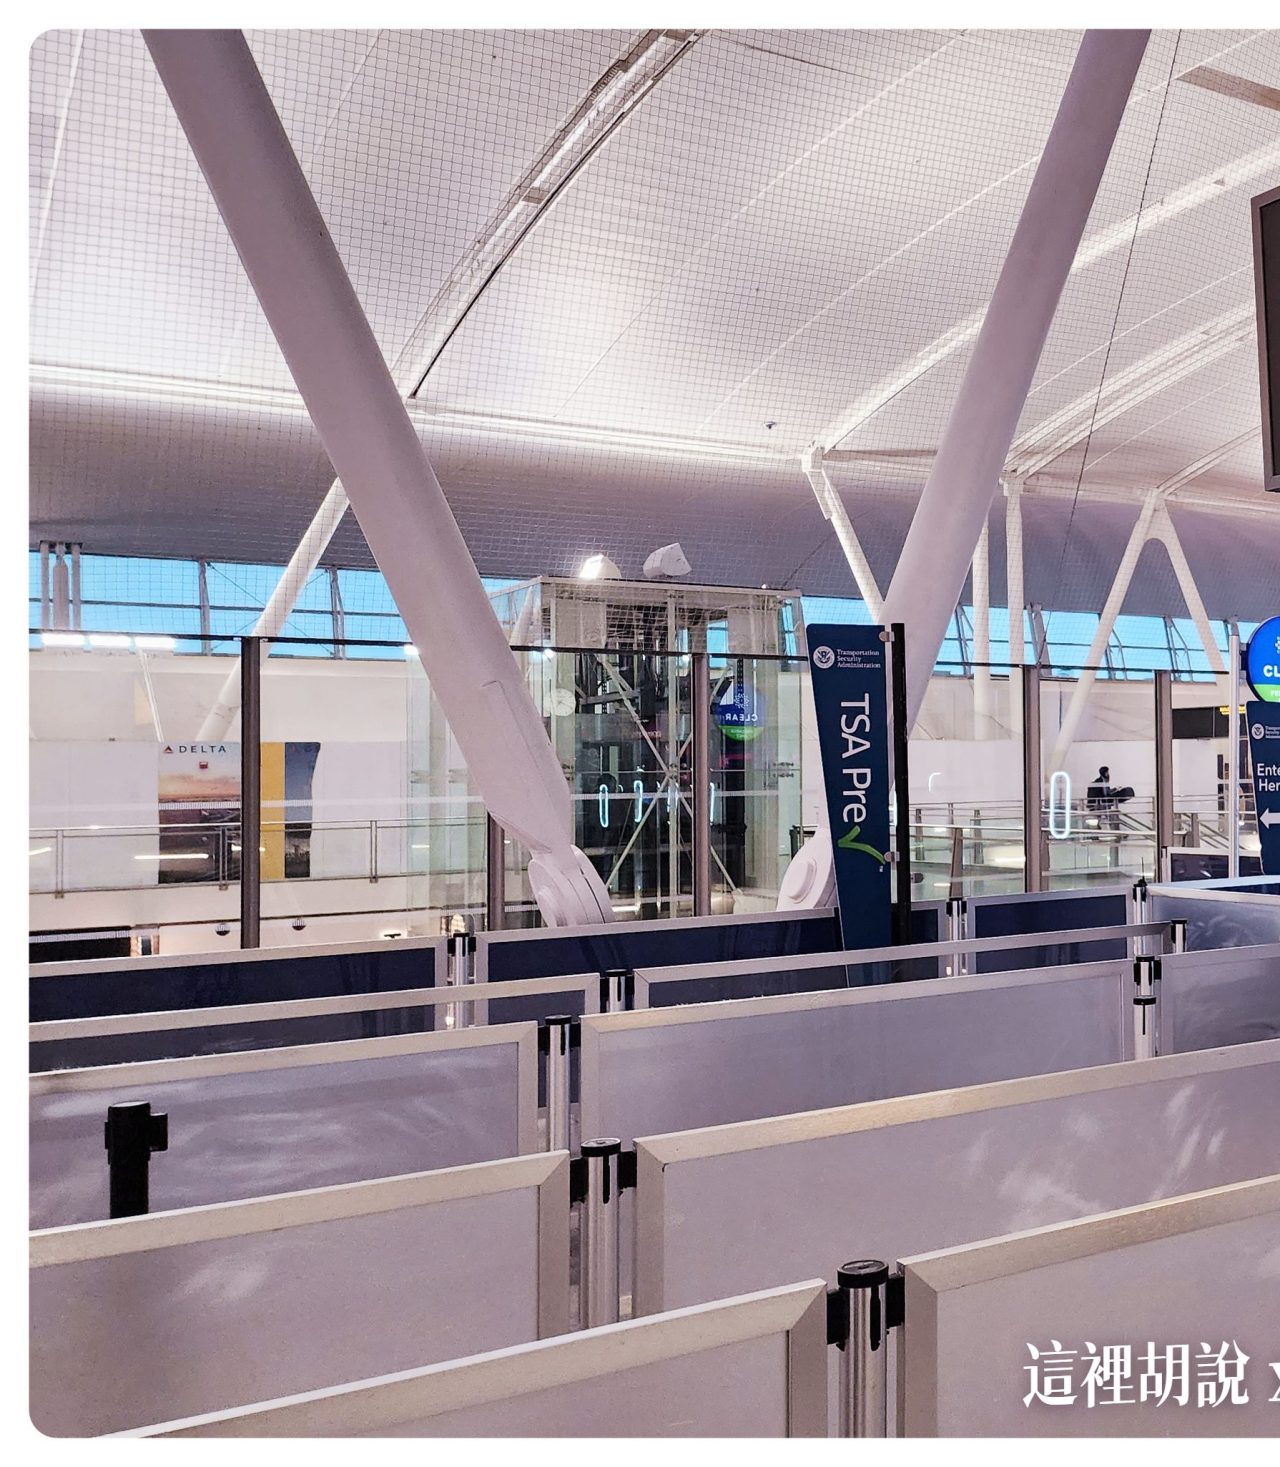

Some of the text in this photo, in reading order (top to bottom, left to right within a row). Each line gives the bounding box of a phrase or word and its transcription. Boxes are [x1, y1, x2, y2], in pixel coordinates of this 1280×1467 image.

[836, 655, 862, 663] Security
[178, 745, 227, 754] DELTA
[840, 693, 872, 823] TSA Pre
